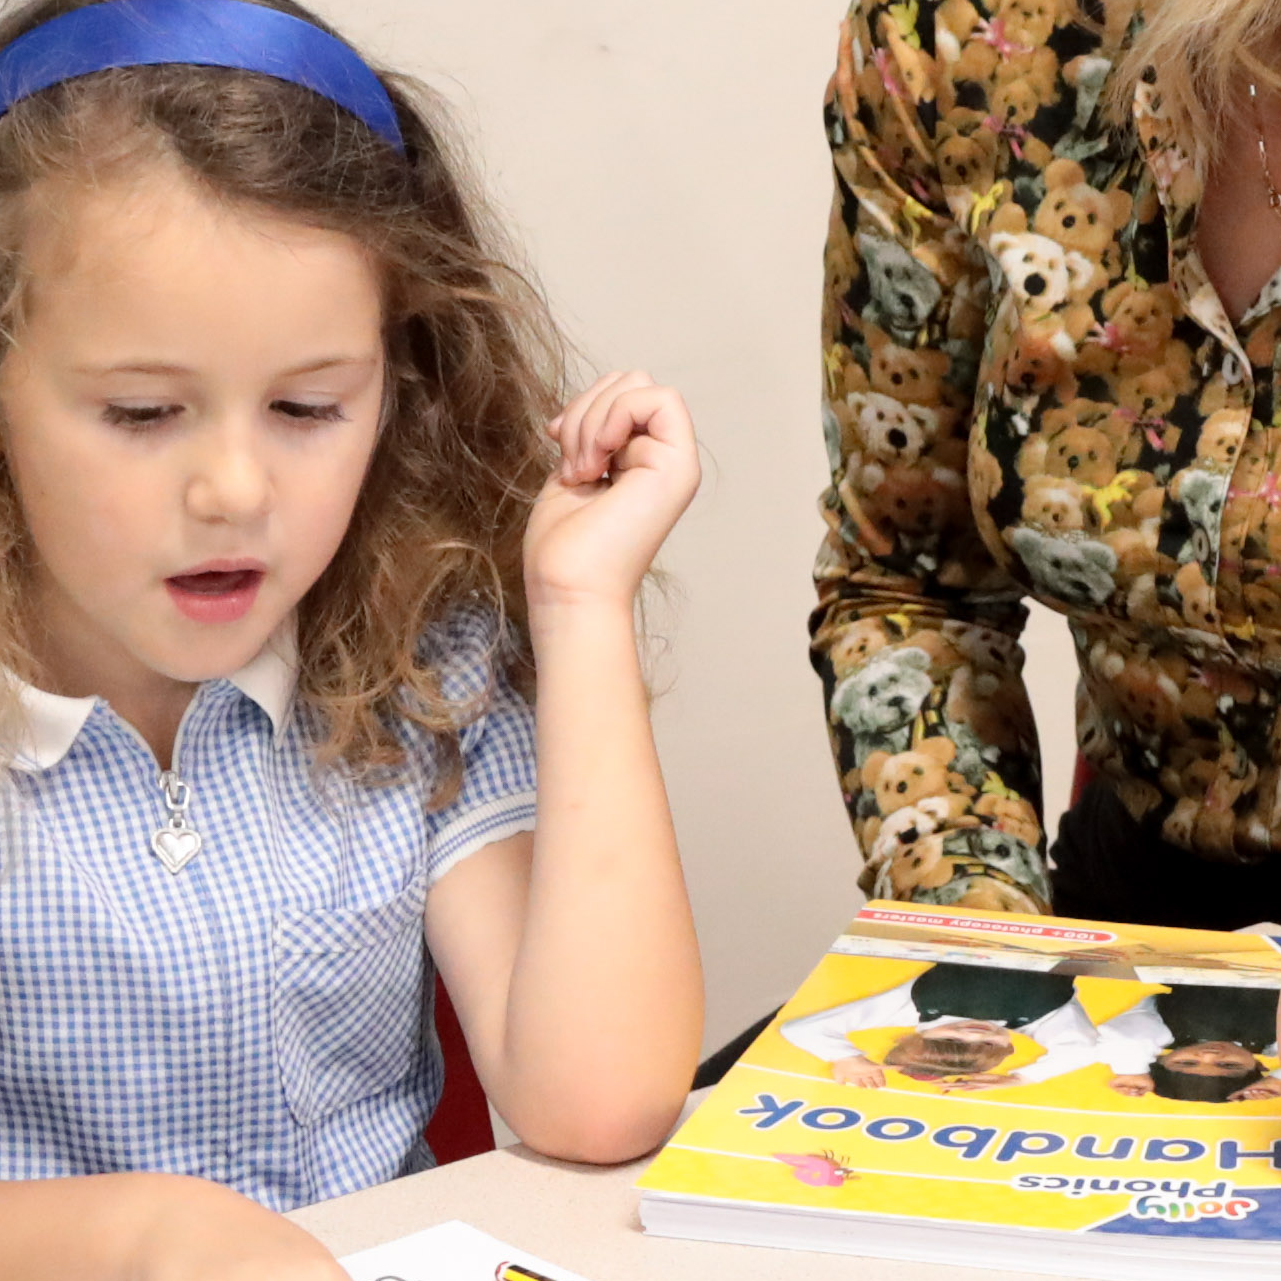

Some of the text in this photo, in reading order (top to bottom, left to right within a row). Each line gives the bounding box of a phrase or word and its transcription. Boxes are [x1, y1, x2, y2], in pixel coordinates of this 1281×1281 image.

[874, 912, 1097, 941] 100+ photocopy masters
[1018, 1174, 1235, 1200] Phonics
[1135, 1195, 1255, 1223] Jolly
